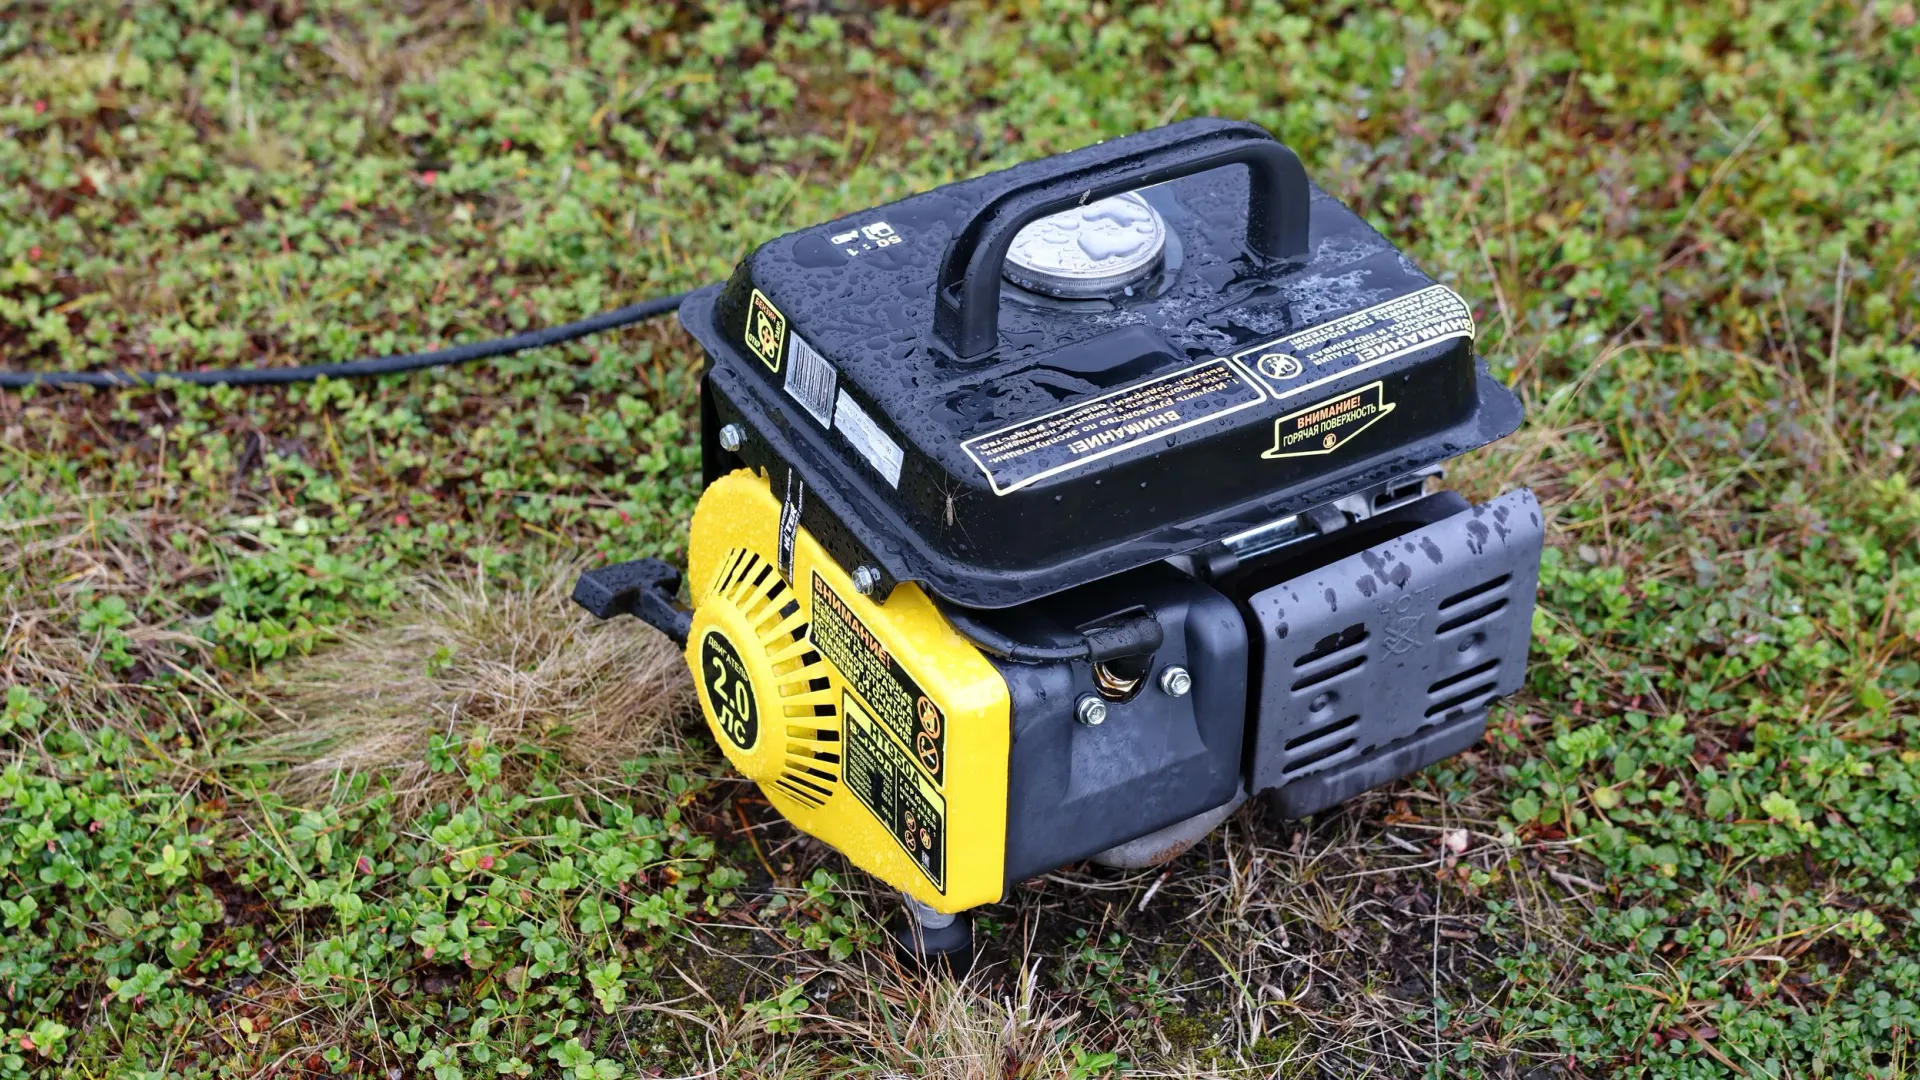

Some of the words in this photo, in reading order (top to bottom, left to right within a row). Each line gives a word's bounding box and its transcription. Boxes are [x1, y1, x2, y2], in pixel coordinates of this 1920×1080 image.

[1368, 287, 1446, 317] ОСТАНОВКЕ
[1373, 291, 1452, 322] ЗАПРАВЛЯТЬ
[1391, 296, 1458, 323] БЕНЗИНА!
[1287, 312, 1369, 345] ДВИГАТЕЛЯ!
[1346, 318, 1375, 332] ПРИ
[1375, 327, 1387, 335] И
[1386, 310, 1439, 332] УТЕЧКАХ
[1293, 328, 1347, 351] ПОЛНОЙ
[1305, 331, 1376, 360] ПЕРЕЛИВАХ
[1311, 331, 1396, 365] ЭКСПЛУАТАЦИЯ
[1352, 317, 1475, 362] ВНИМАНИЕ!
[1124, 380, 1201, 409] использовать
[1175, 381, 1227, 403] Изучить
[1201, 375, 1219, 384] Не
[1056, 407, 1116, 431] закрытых
[1080, 422, 1098, 432] по
[1098, 397, 1175, 427] руководство
[1283, 424, 1319, 447] ГОРЯЧАЯ
[1320, 403, 1377, 433] ПОВЕРХНОСТЬ
[1297, 395, 1361, 430] ВНИМАНИЕ!
[974, 423, 1046, 451] вещества.
[979, 427, 1057, 456] помещениях,
[987, 429, 1080, 465] эксплуатации.
[1065, 409, 1181, 454] ВНИМАНИЕ!
[814, 574, 890, 671] ВНИМАНИЕ!
[708, 635, 749, 682] ДВИГАТЕЛЬ
[814, 590, 862, 651] ИСКЛЮЧИТЬ
[864, 646, 912, 707] ПОЯВЛЕНИЕ
[814, 600, 850, 648] ВБЛИЗИ
[852, 643, 912, 717] ГЕНЕРАТОРА
[814, 609, 863, 673] ИСТОЧНИКОВ
[865, 668, 912, 728] ОТКРЫТОГО
[814, 620, 859, 678] ПЛАМЕНИ
[862, 674, 869, 690] И
[872, 685, 911, 736] ОЧАГОВ
[712, 656, 750, 722] 2.0
[814, 629, 864, 695] ТЛЕЮЩЕГО
[866, 689, 911, 748] ГОРЕНИЯ!
[719, 704, 746, 745] ЛС
[849, 720, 892, 777] ВЫХОД
[870, 722, 920, 790] HT950A
[899, 776, 936, 823] ГОРЮЧЕЕ
